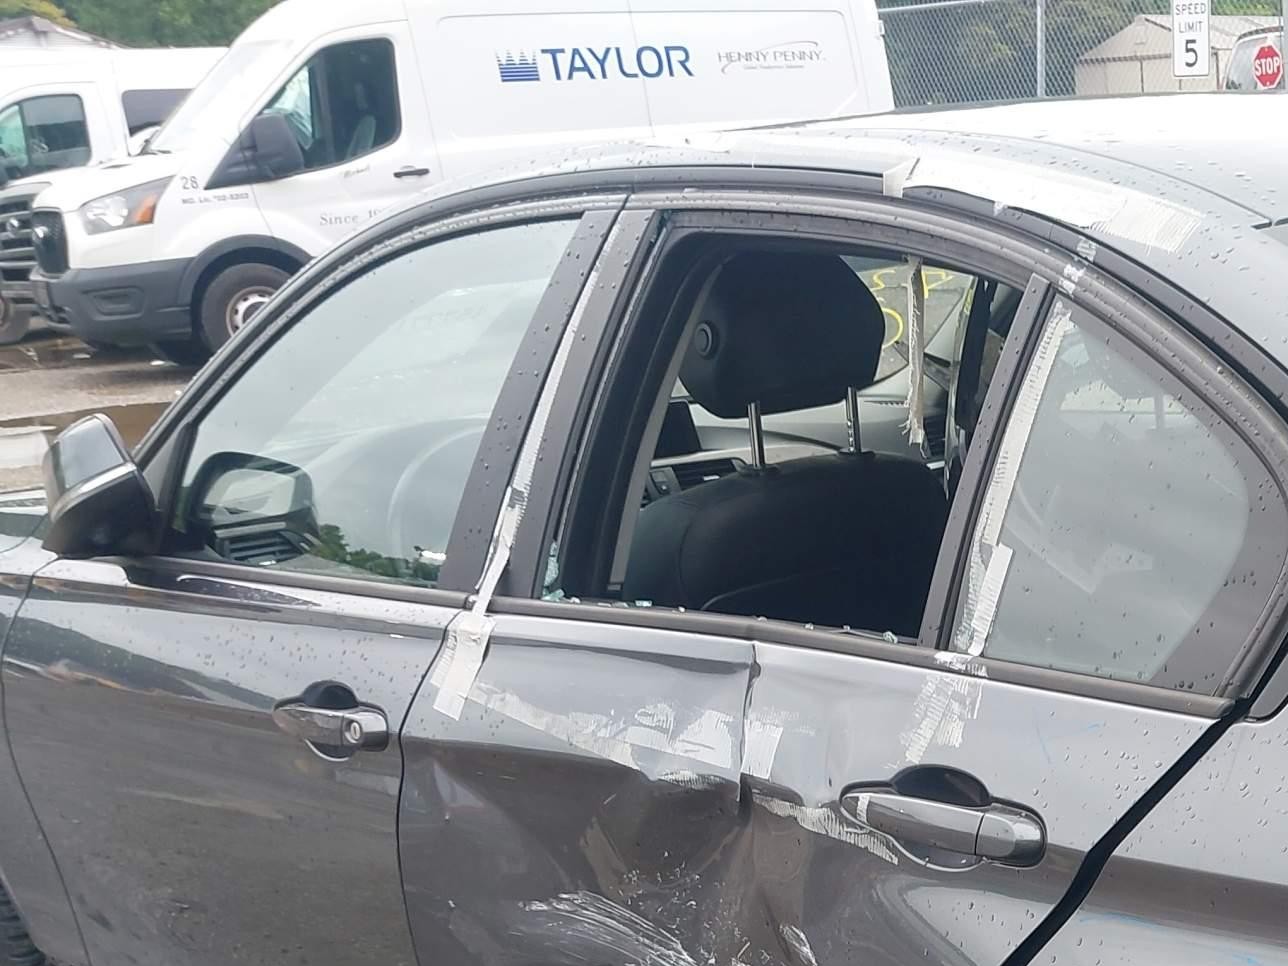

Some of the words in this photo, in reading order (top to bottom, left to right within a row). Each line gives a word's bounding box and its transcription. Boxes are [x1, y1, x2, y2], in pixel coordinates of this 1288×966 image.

[1175, 2, 1206, 15] SPEED
[1179, 20, 1204, 33] LIMIT
[717, 51, 769, 63] HENNY
[773, 50, 822, 61] PENNY
[1184, 39, 1198, 67] 5
[541, 45, 694, 81] TAYLOR
[1254, 56, 1280, 76] STOP
[320, 212, 359, 226] Since
